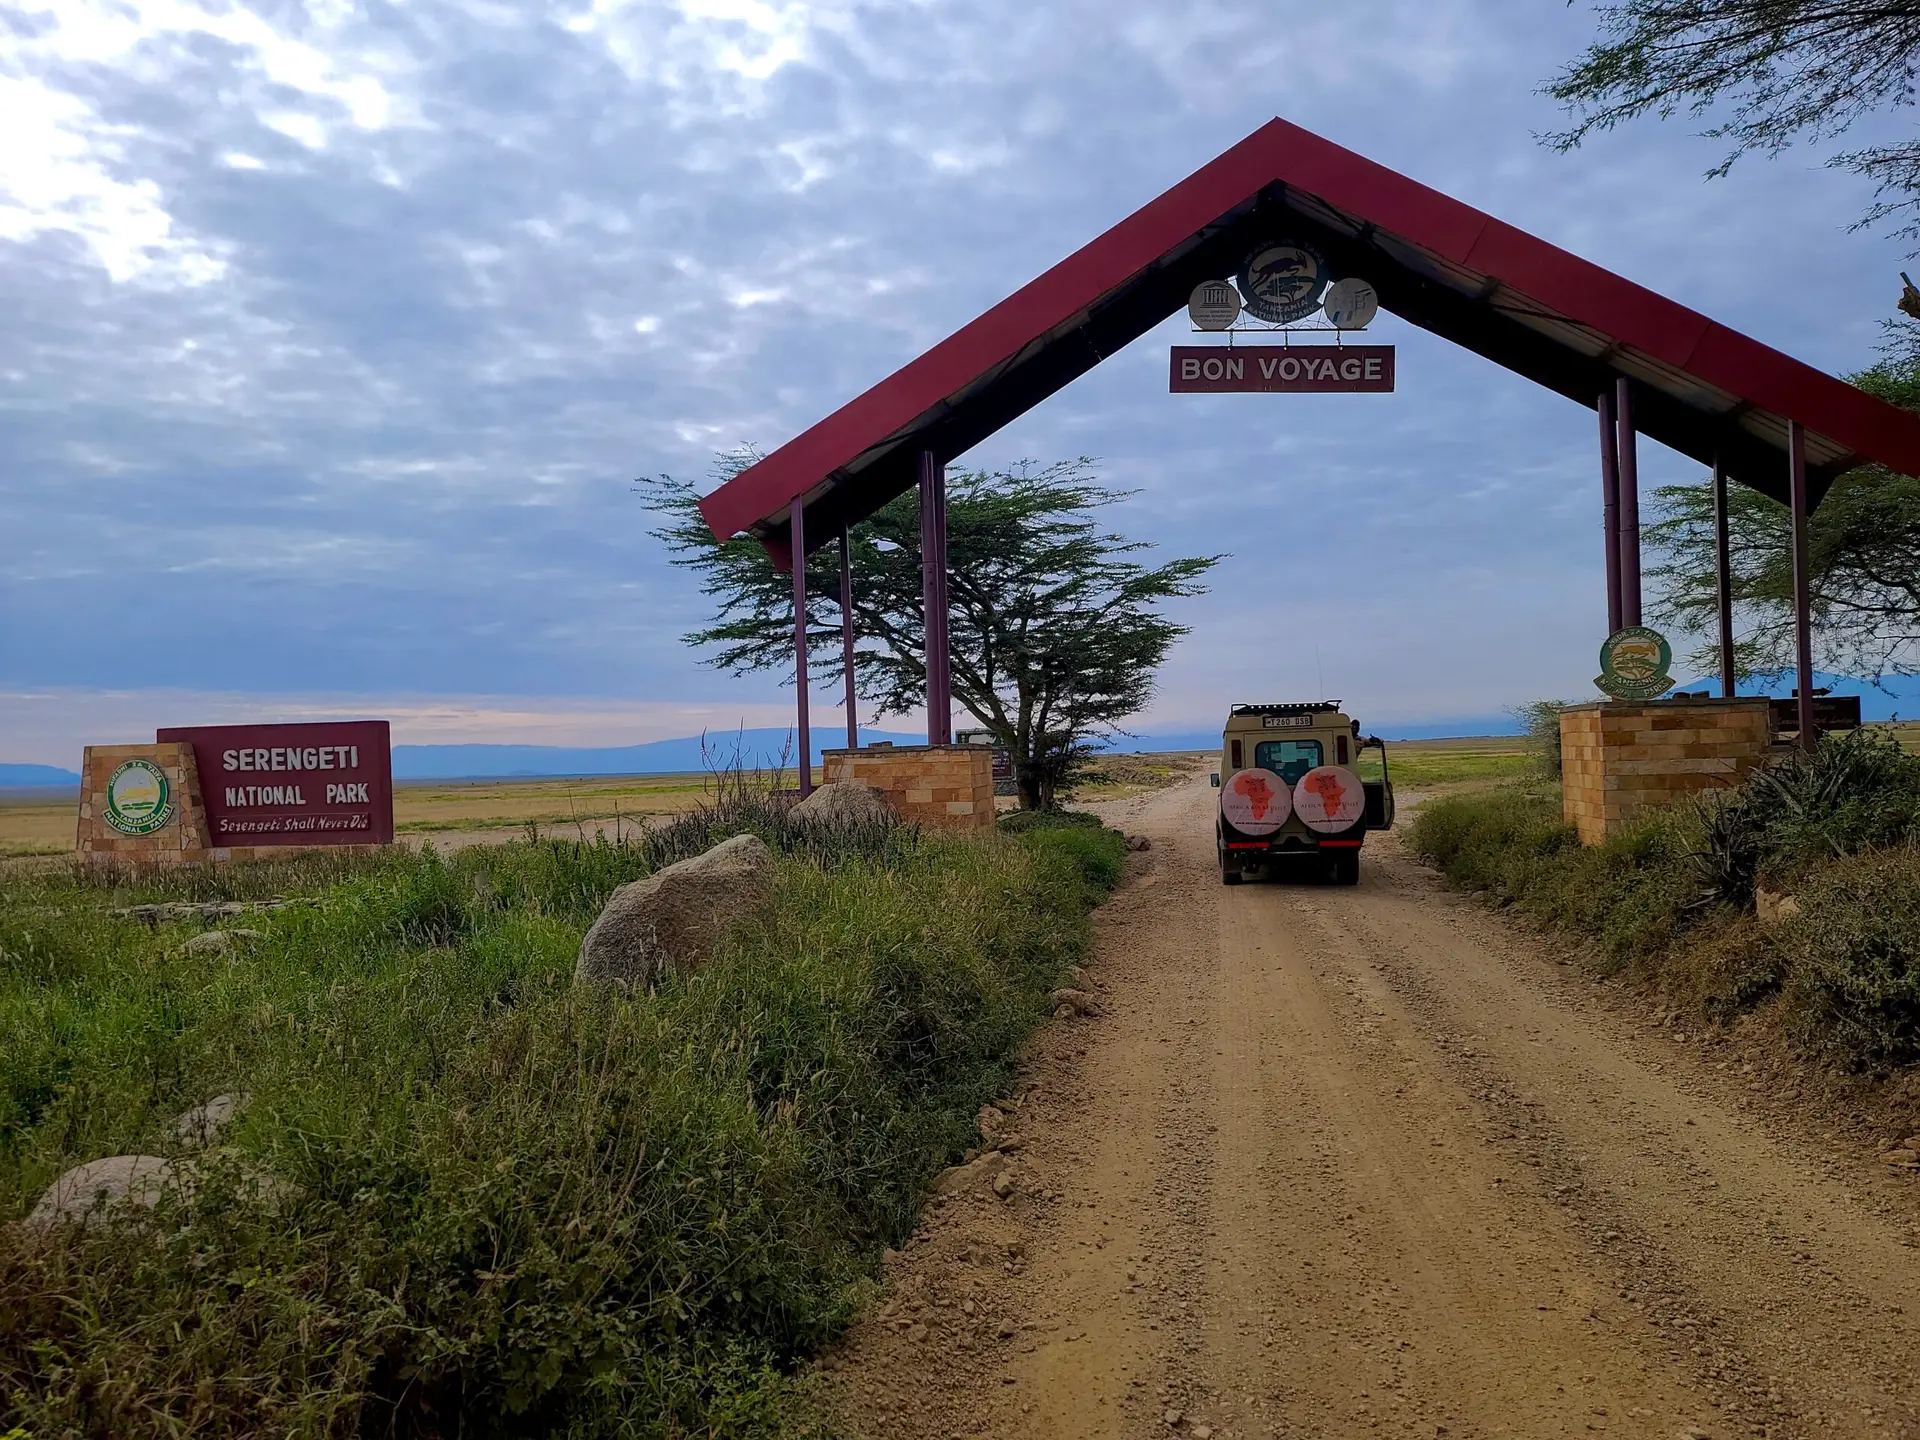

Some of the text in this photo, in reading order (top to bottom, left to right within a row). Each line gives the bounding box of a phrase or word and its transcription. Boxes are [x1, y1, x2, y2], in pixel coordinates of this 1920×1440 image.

[1247, 305, 1290, 321] NATIONAL
[1259, 299, 1308, 313] TANZANIA
[1181, 357, 1382, 380] BON VOYAGE
[222, 745, 359, 771] SERENGETI
[147, 765, 163, 783] TAIFA
[225, 783, 370, 807] NATIONAL PARK
[105, 808, 171, 833] NATIONAL PARKS
[119, 813, 157, 825] TANZANIA
[219, 817, 282, 833] Serengeti
[284, 816, 316, 830] Shall
[317, 815, 348, 829] Never
